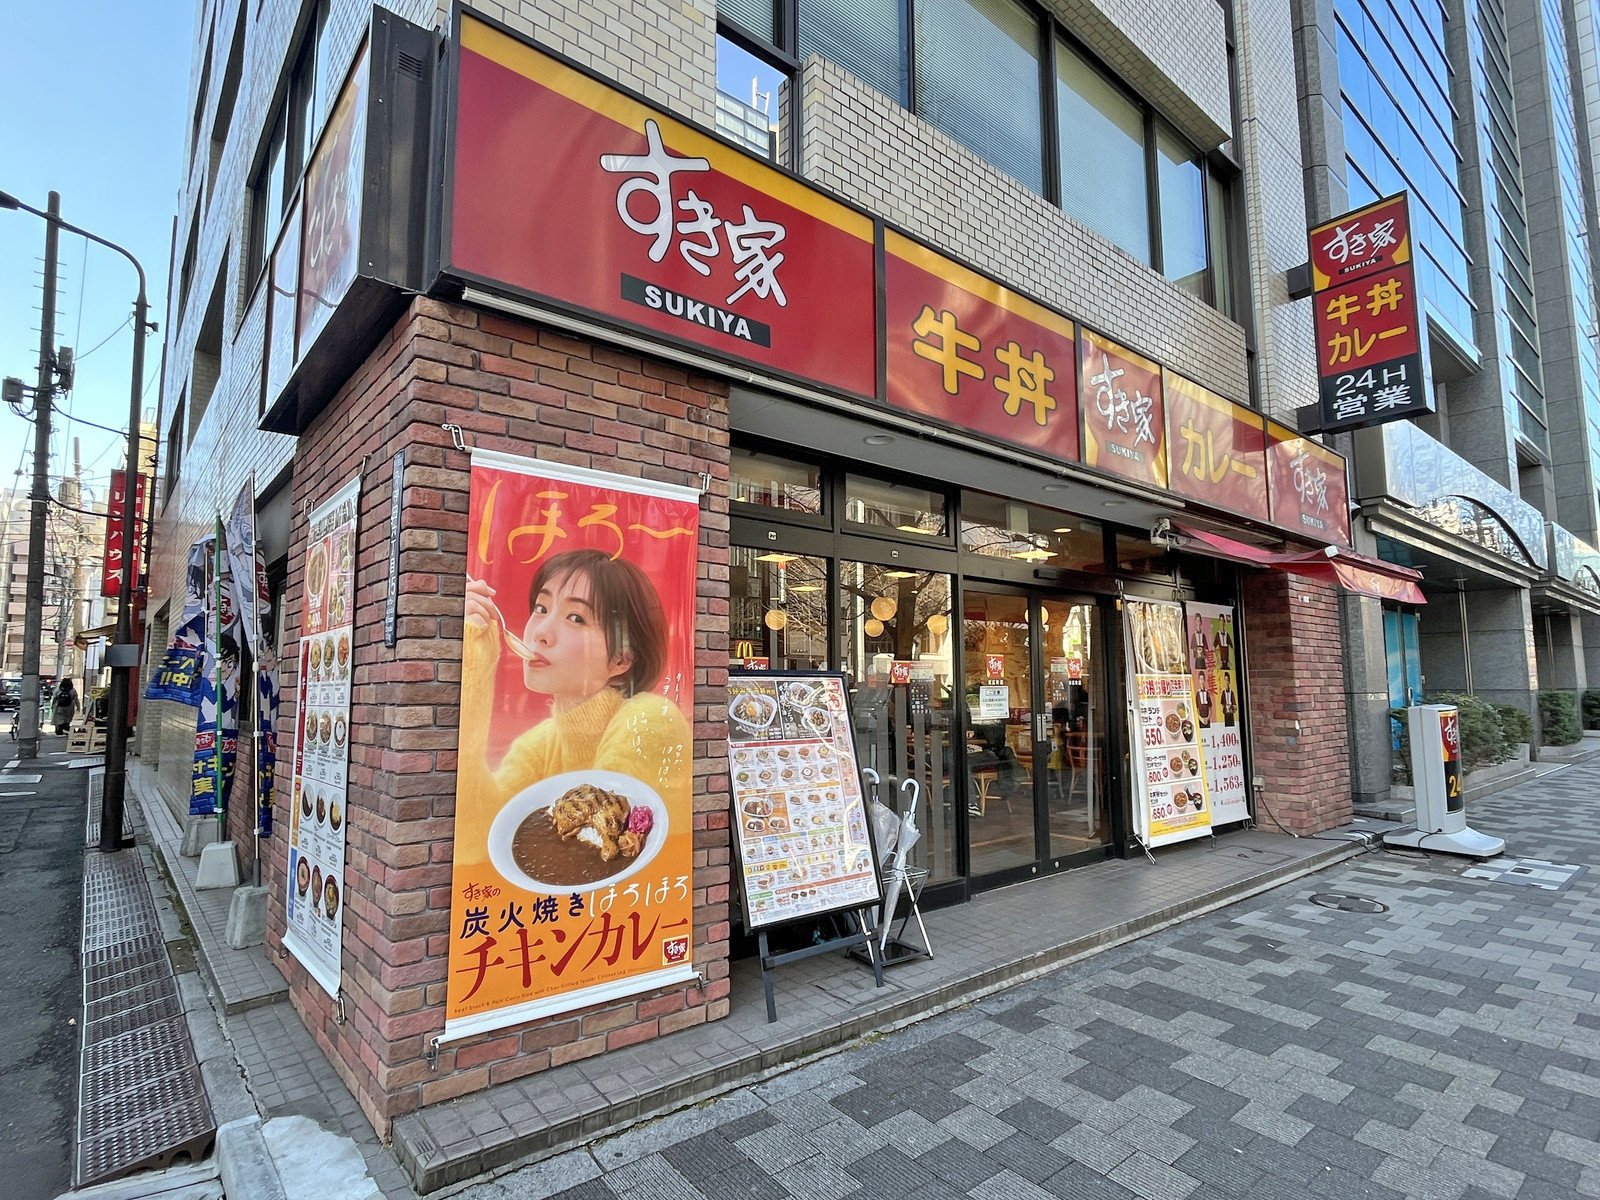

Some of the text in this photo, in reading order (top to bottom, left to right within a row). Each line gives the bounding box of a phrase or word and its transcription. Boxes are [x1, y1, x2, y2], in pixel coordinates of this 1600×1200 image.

[600, 119, 787, 306] すき家
[1323, 218, 1397, 263] すき家
[1344, 258, 1377, 273] SUKIYA
[644, 285, 752, 340] SUKIYA
[1326, 278, 1404, 325] 牛丼
[911, 304, 1057, 426] 牛丼
[1328, 325, 1408, 366] カレー
[1091, 354, 1156, 447] すき家
[1333, 384, 1412, 420] 営業
[1335, 364, 1406, 397] 24H
[1111, 443, 1140, 461] SUKIYA
[1180, 418, 1258, 483] カレー
[1289, 448, 1329, 515] すき家
[460, 875, 689, 939] 炭火焼き ほろほろ
[462, 882, 501, 901] すき家の
[455, 911, 689, 1004] チキンカレー
[666, 941, 686, 956] すき家
